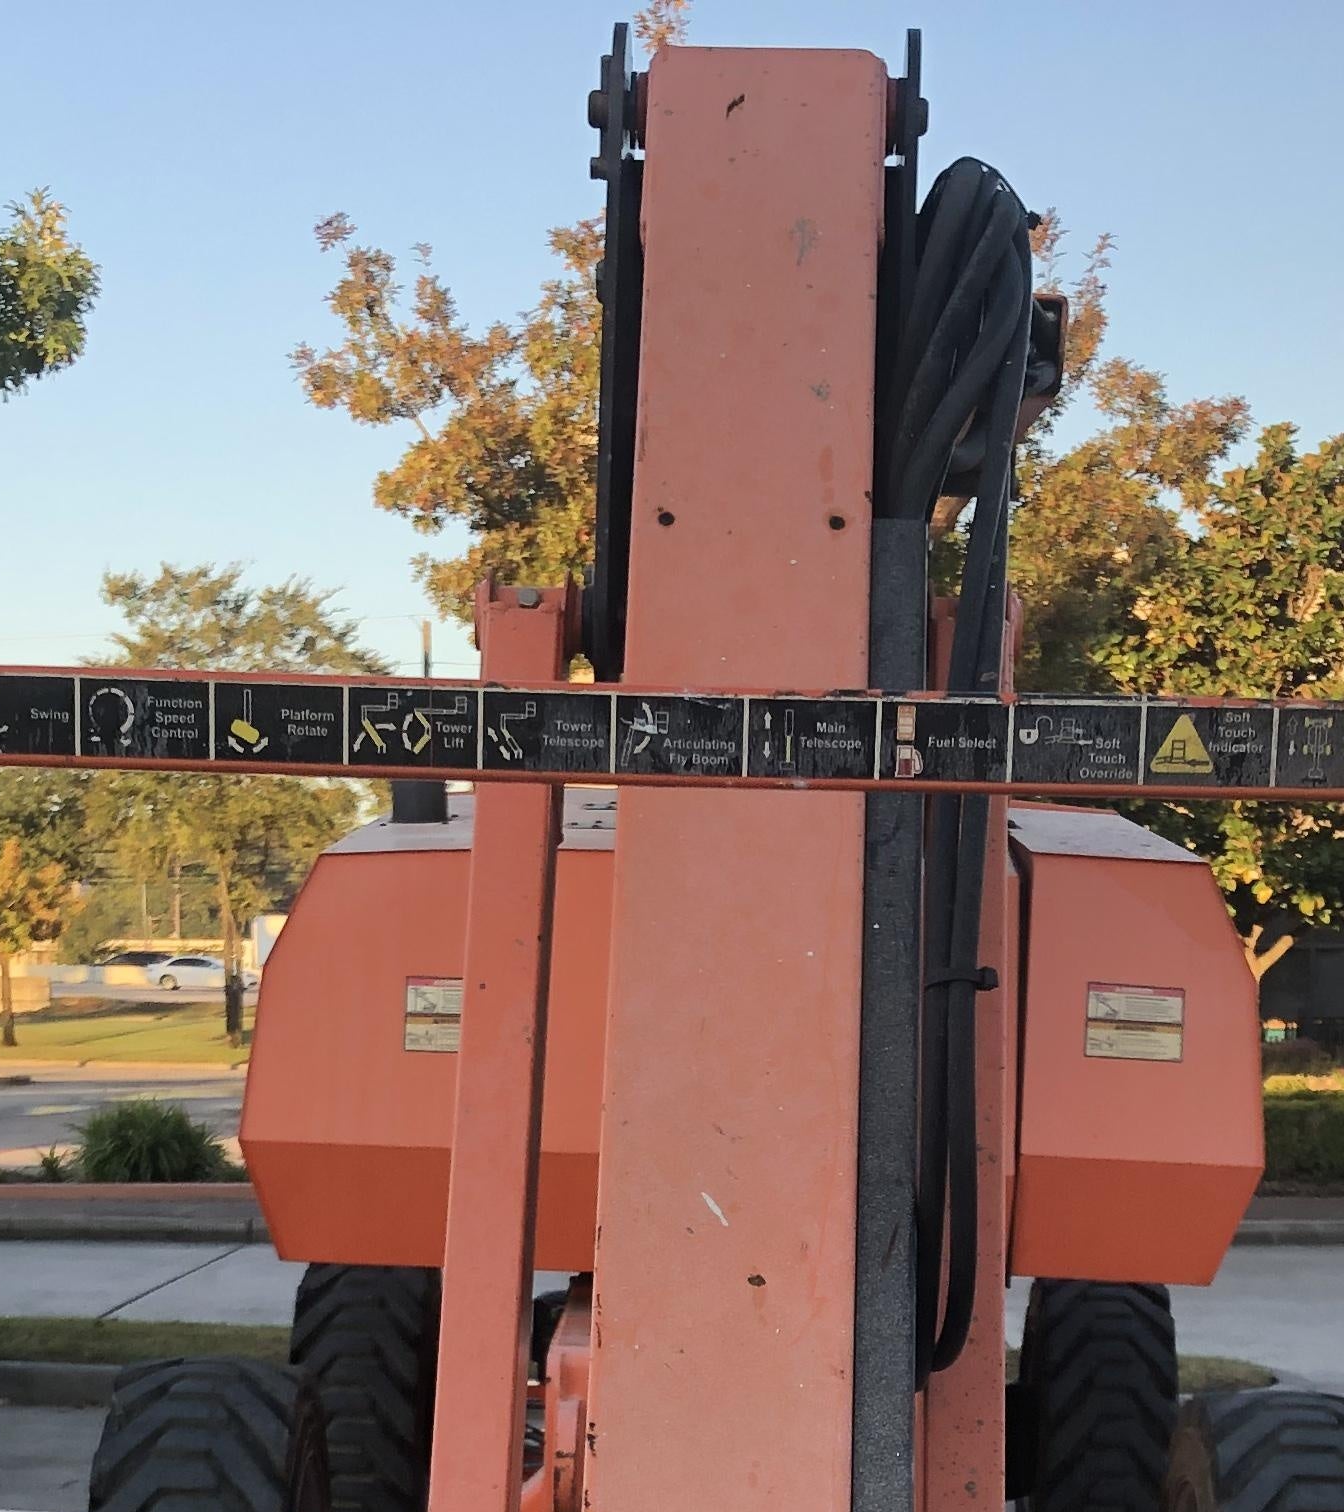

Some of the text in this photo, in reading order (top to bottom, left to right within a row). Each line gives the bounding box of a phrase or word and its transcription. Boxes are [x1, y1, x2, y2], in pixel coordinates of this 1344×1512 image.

[147, 697, 203, 709] Function
[30, 708, 69, 723] Swing
[155, 711, 195, 726] Speed
[281, 710, 335, 722] Platform
[1224, 712, 1250, 724] Soft
[150, 727, 199, 738] Control
[287, 724, 328, 736] Rotate
[435, 721, 473, 734] Tower
[555, 720, 592, 733] Tower
[816, 722, 846, 734] Main
[1218, 727, 1256, 739] Touch
[443, 737, 465, 750] Lift
[542, 736, 605, 750] Telescope
[662, 738, 736, 753] Articulating
[800, 737, 862, 750] Telescope
[928, 736, 996, 749] Fuel Select
[1095, 737, 1121, 750] Soft
[1208, 741, 1264, 754] Indicator
[669, 753, 729, 766] Fly Boom
[1088, 752, 1126, 765] Touch
[1079, 768, 1134, 780] Override
